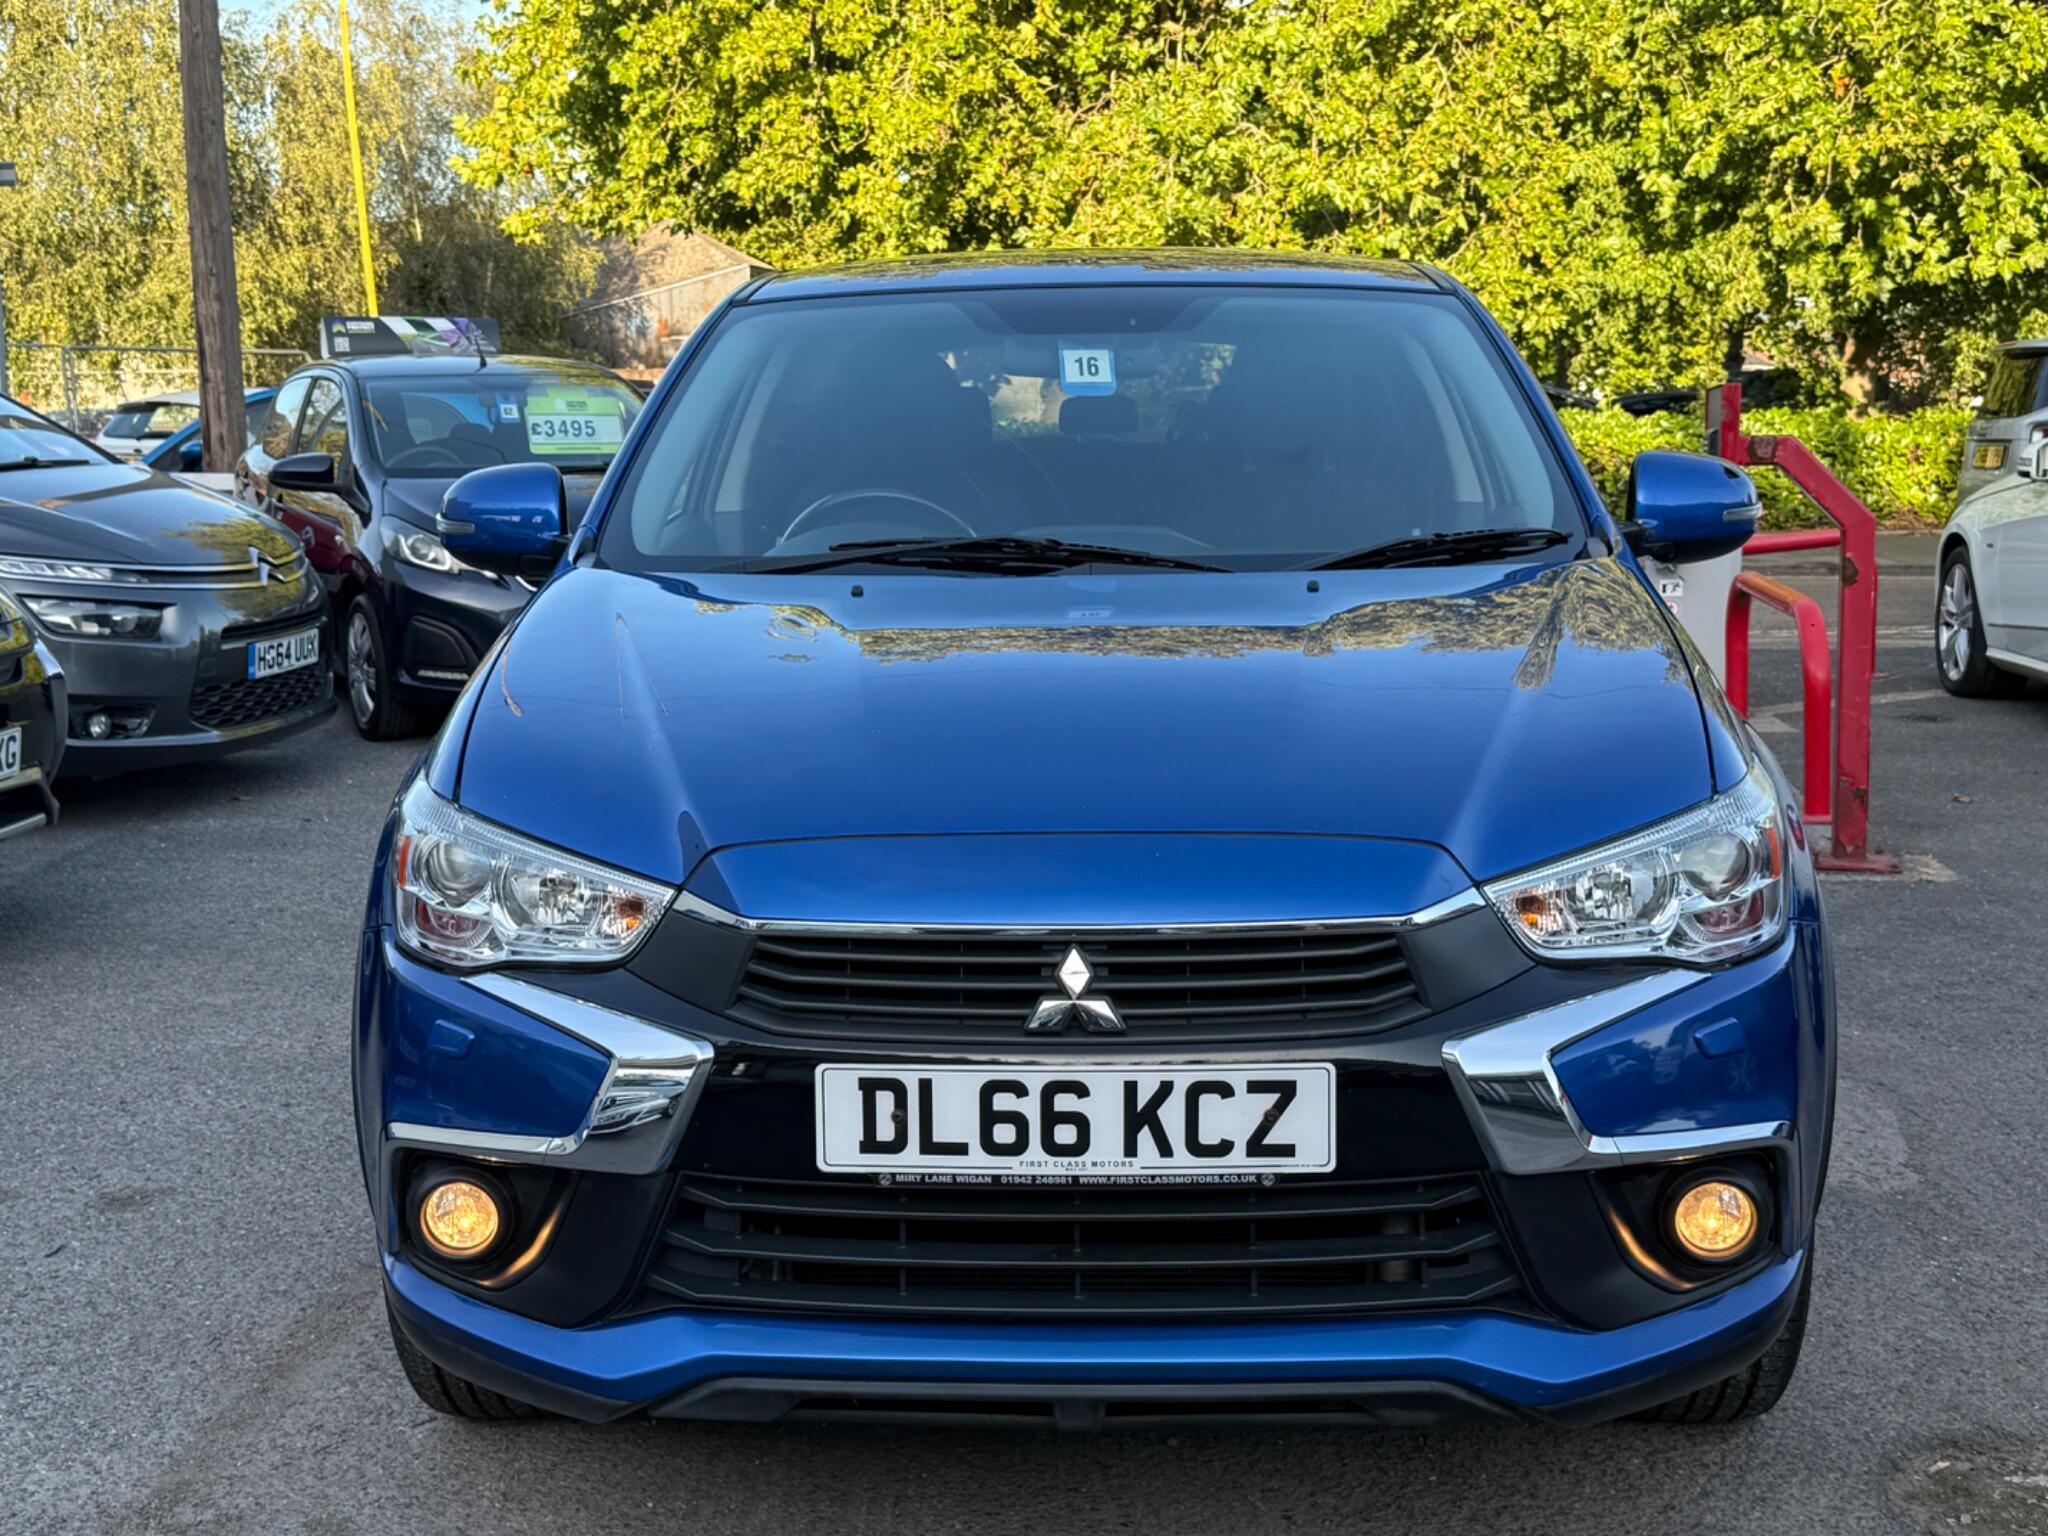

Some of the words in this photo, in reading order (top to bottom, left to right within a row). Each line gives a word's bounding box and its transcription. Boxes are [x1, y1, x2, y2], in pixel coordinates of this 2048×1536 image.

[1074, 356, 1099, 376] 16
[531, 419, 596, 438] £3495
[858, 1077, 1091, 1158] DL66
[1123, 1079, 1298, 1159] KCZ
[1019, 1160, 1048, 1168] FIRST
[1053, 1160, 1087, 1168] CLASS
[1091, 1160, 1134, 1168] MOTORS
[895, 1173, 922, 1183] MIRY
[925, 1174, 953, 1184] LANE
[956, 1175, 992, 1184] WIGAN
[1079, 1174, 1257, 1185] WWW.FIRSTCLASSMOTORS.CO.UK
